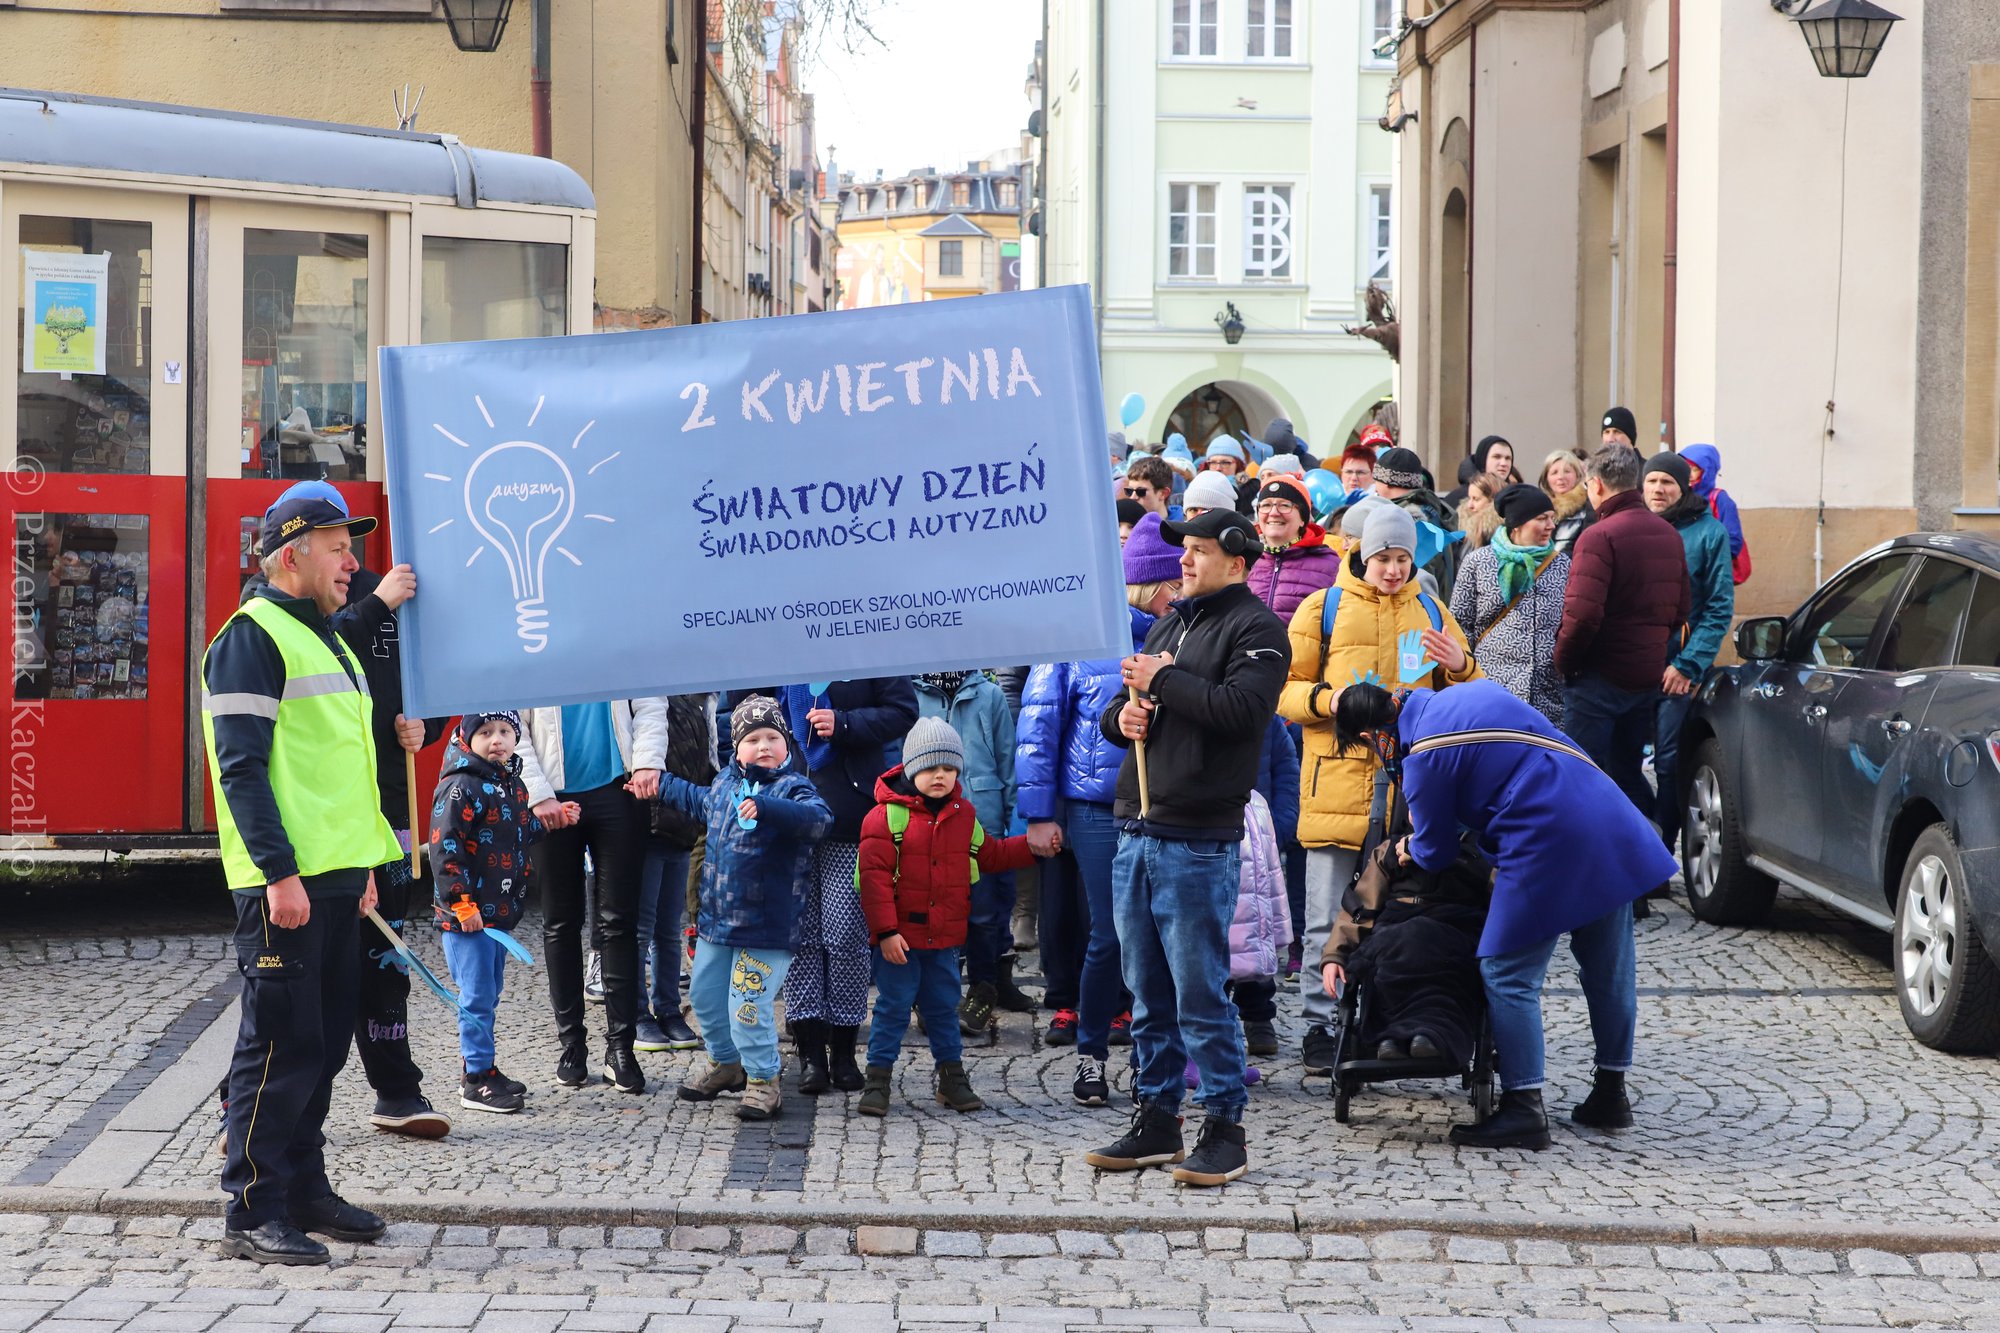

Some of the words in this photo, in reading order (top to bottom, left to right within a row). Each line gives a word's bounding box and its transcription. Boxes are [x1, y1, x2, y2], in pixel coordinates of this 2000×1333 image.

[680, 382, 716, 433] 2
[741, 346, 1042, 425] KWIETNIA
[491, 482, 562, 501] autyzm
[692, 475, 904, 526] ŚWIATOWY
[922, 442, 1046, 503] DZIEŃ
[282, 516, 302, 531] STRAŻ
[699, 515, 896, 559] ŚWIADOMOŚCI
[908, 502, 1049, 540] AUTYZMU
[682, 605, 778, 629] SPECJALNY
[781, 597, 865, 620] OŚRODEK
[868, 574, 1087, 613] SZKOLNO-WYCHOWAWCZY
[805, 623, 823, 639] W
[825, 615, 901, 638] JELENIEJ
[904, 609, 963, 630] GÓRZE
